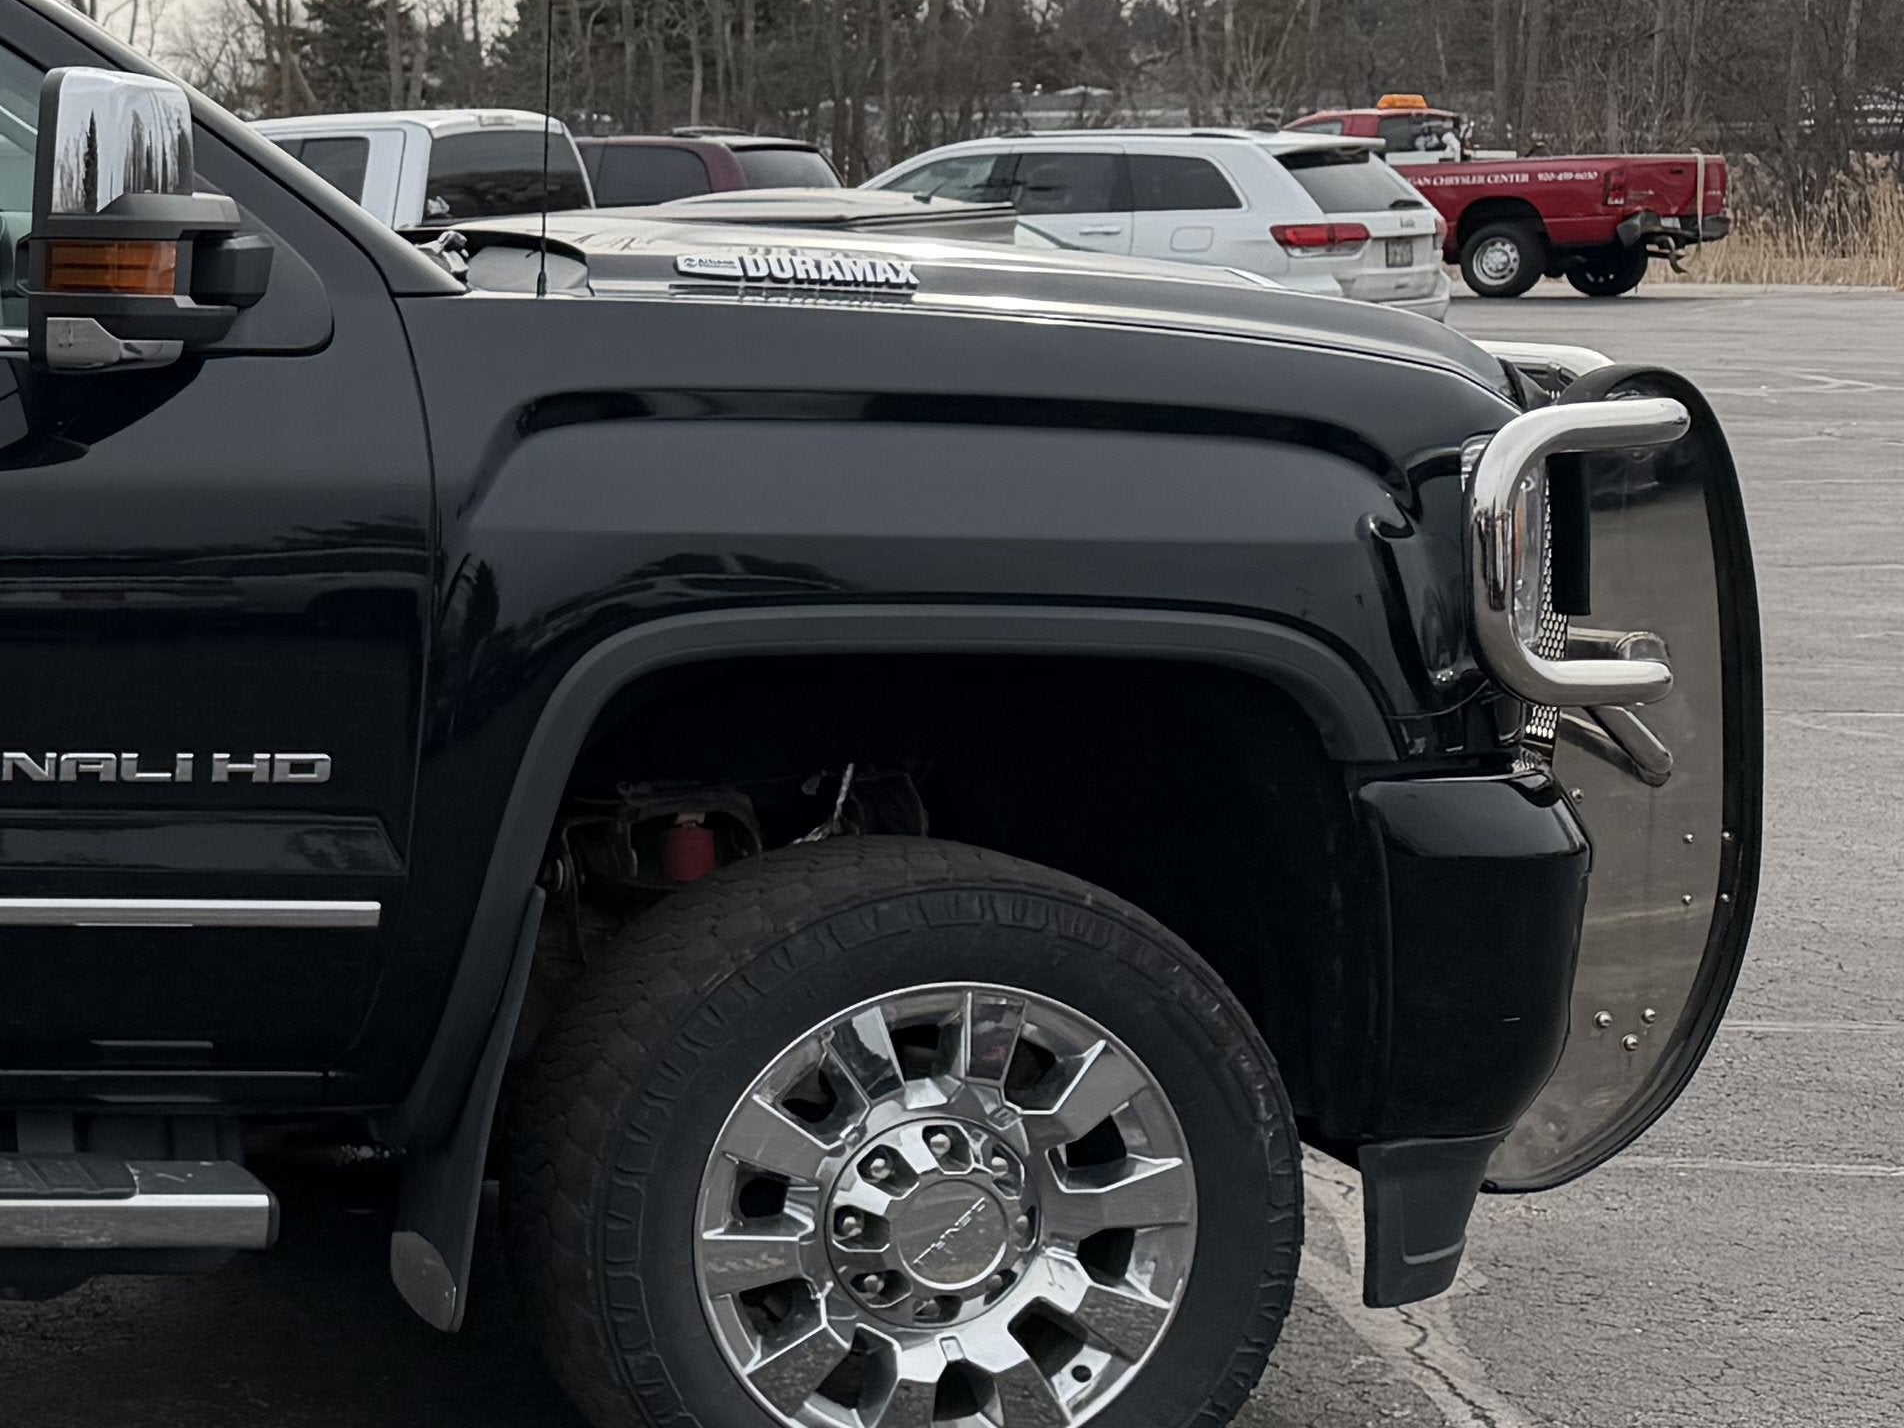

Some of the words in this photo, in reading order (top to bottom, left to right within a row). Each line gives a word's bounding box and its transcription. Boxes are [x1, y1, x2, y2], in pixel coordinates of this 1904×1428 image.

[1433, 175, 1485, 186] CHRYSLER
[1487, 173, 1529, 185] CENTER
[743, 255, 920, 288] DURAMAX
[211, 752, 332, 784] HD
